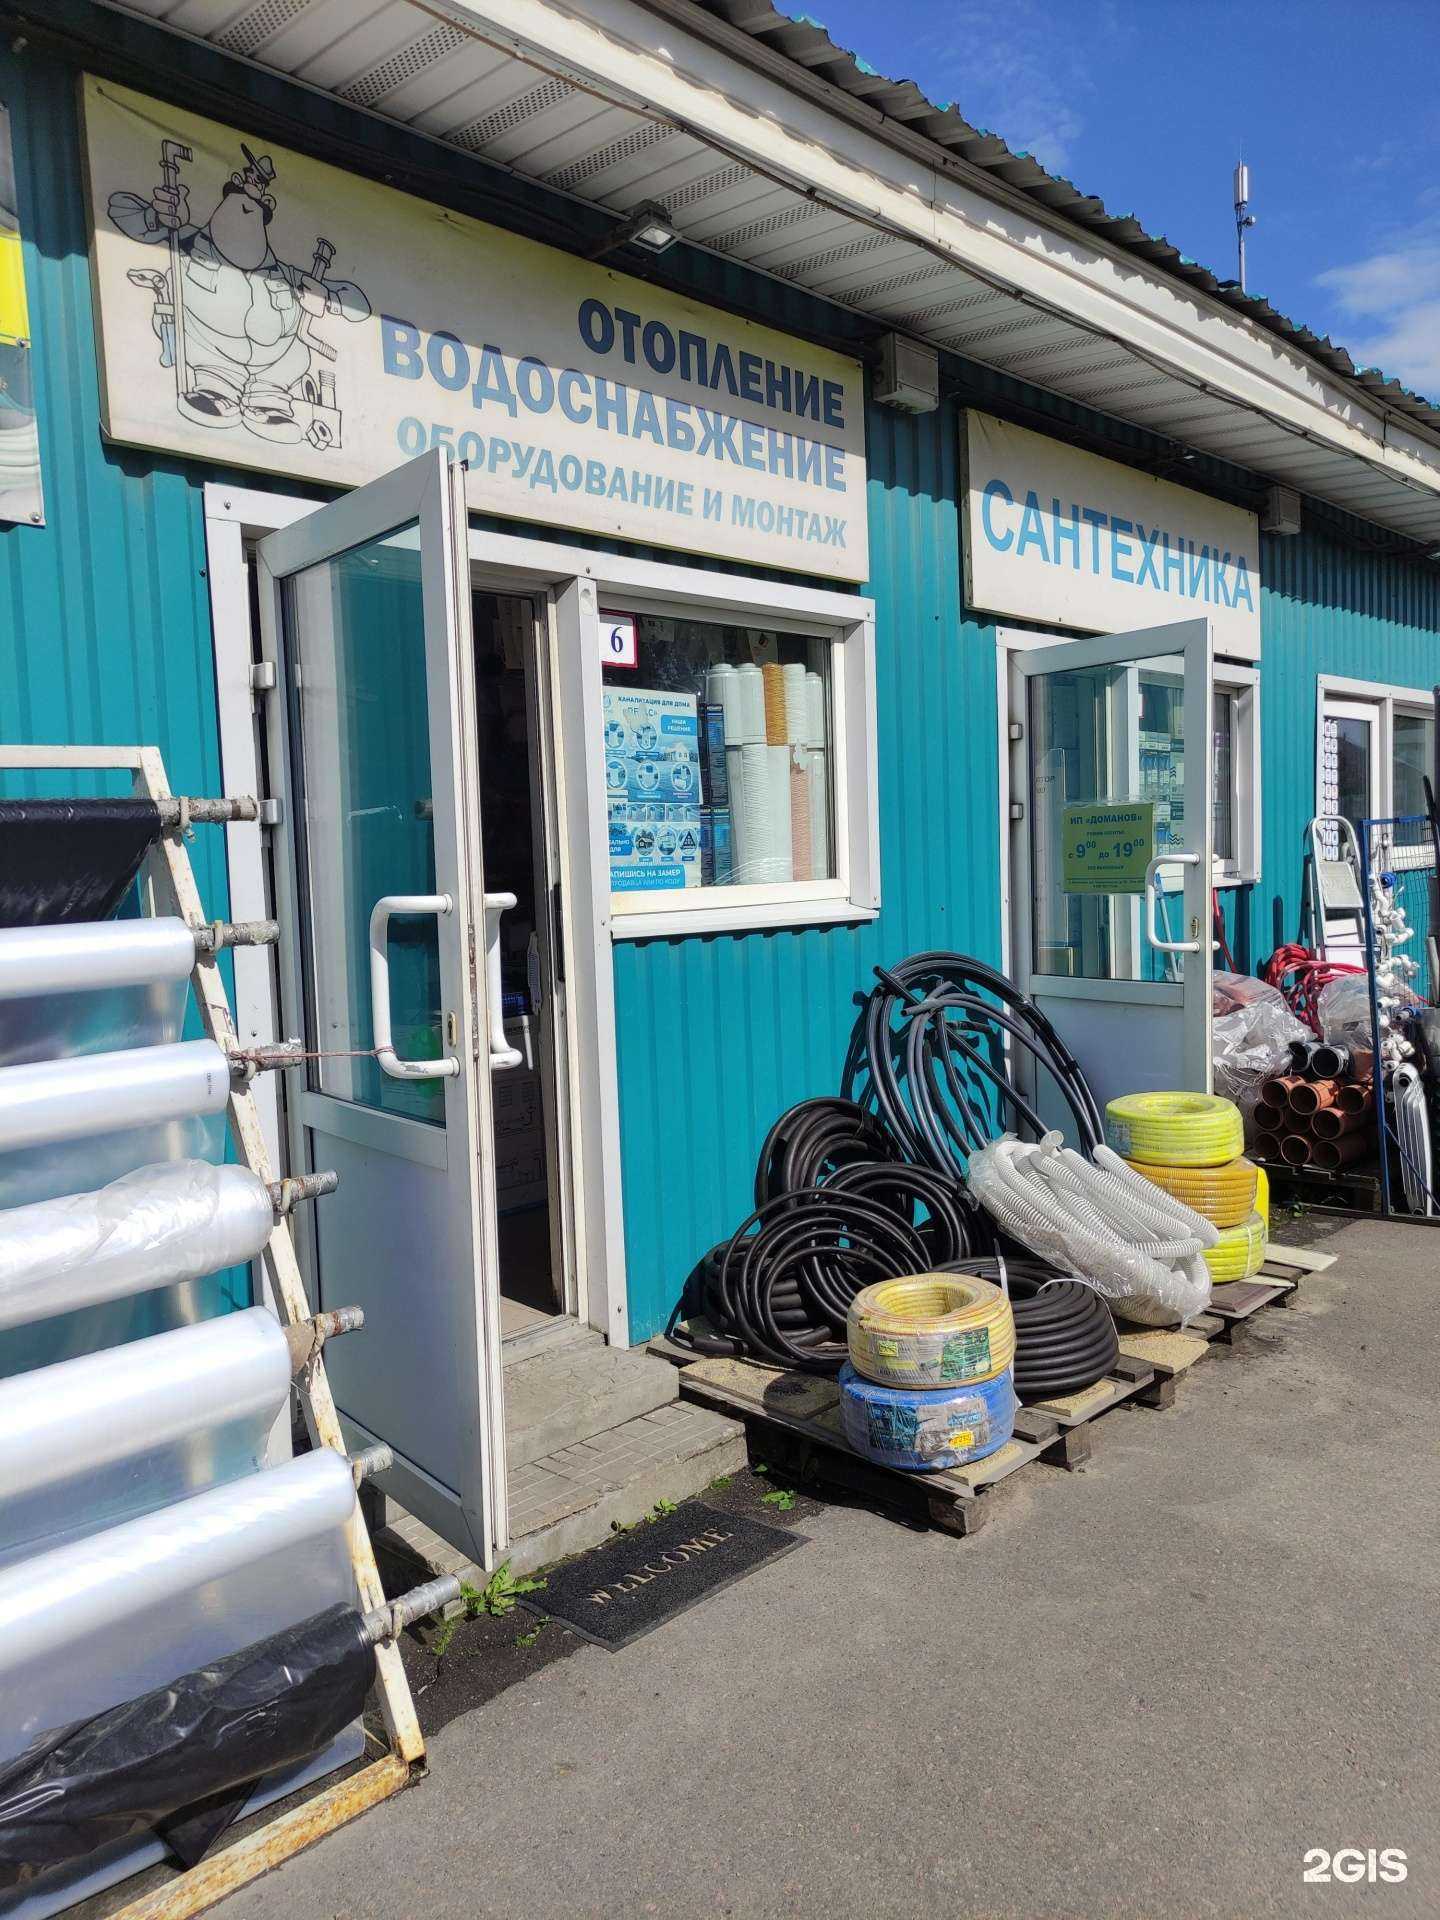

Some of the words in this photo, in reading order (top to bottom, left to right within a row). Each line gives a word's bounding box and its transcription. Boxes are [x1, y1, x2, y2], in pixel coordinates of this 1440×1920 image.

[578, 297, 846, 429] ОТОПЛЕНИЕ
[380, 313, 847, 492] ВОДОСНАБЖЕНИЕ
[702, 489, 723, 522] И
[731, 493, 847, 548] МОНТАЖ
[981, 479, 1254, 613] САНТЕХНИКА
[610, 626, 624, 653] 6
[1070, 816, 1083, 824] ИП
[587, 1527, 735, 1605] WELCOME
